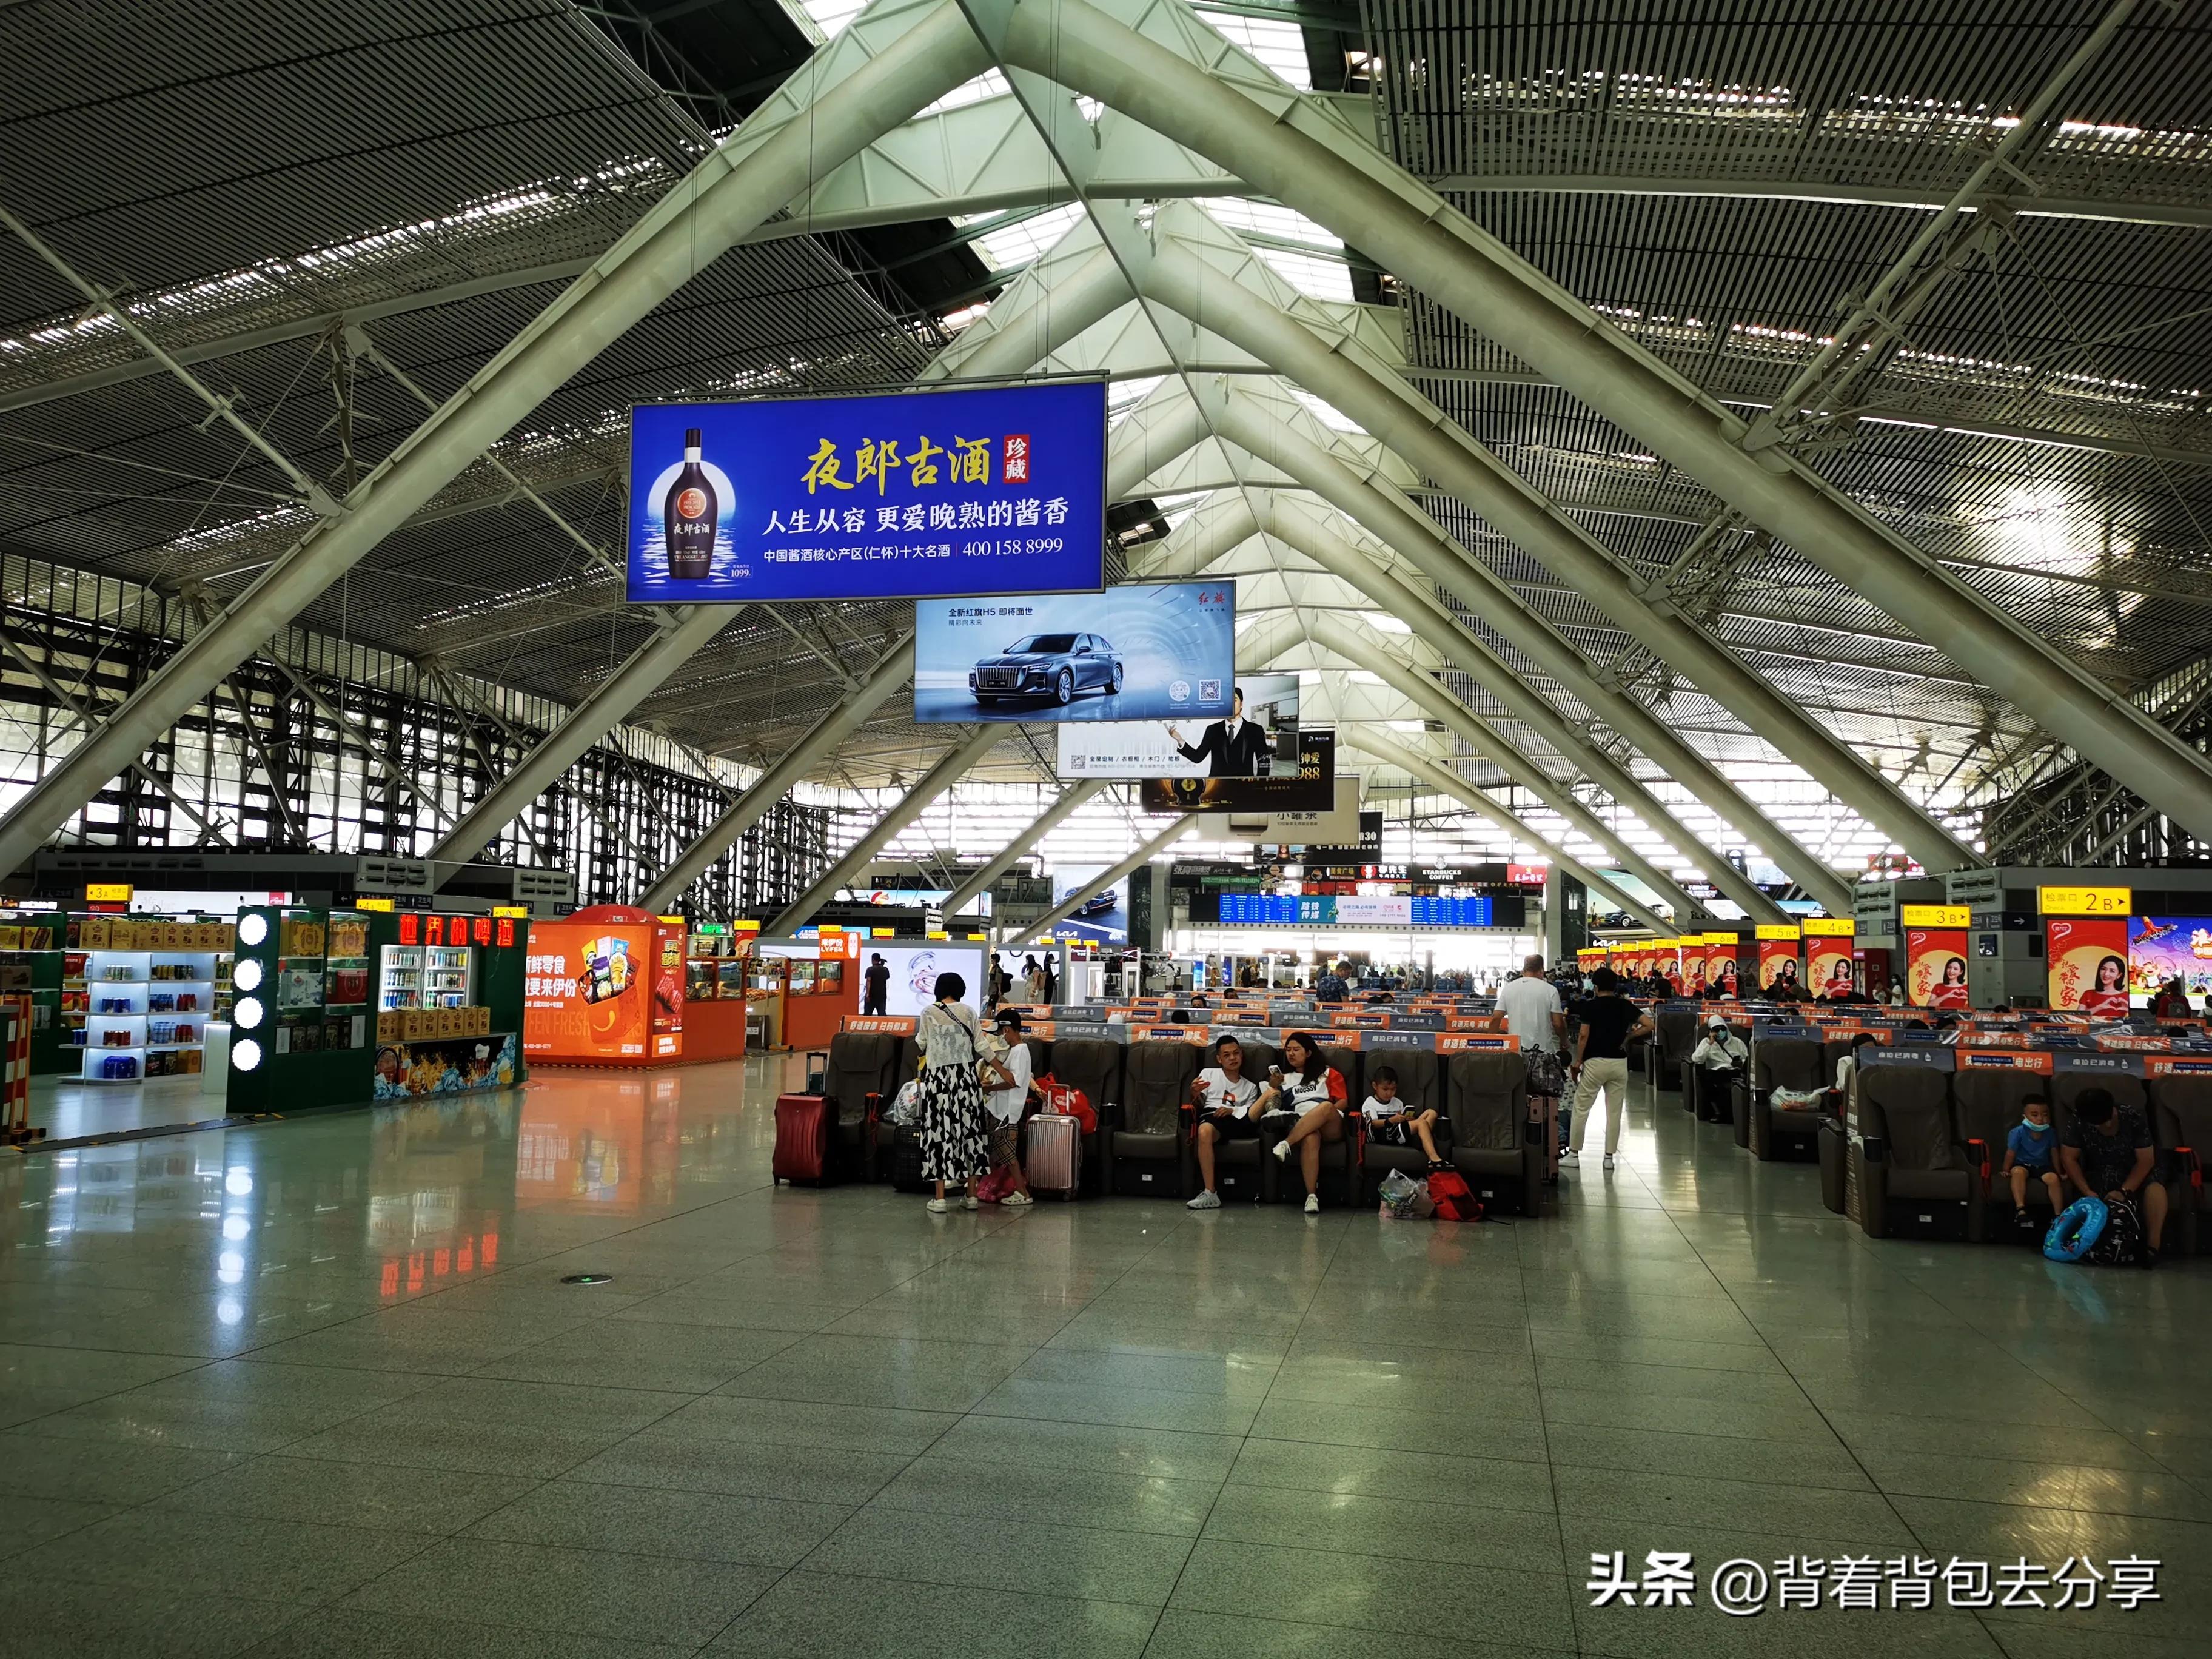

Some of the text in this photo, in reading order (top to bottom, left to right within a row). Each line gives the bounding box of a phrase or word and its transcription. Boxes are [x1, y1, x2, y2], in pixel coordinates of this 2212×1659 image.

[800, 435, 991, 496] 夜郎古酒
[1005, 438, 1027, 480] 珍藏
[762, 497, 1070, 536] 人生从容 更爱晚熟的酱香
[674, 523, 710, 536] 夜郎古酒
[764, 538, 1064, 563] 中国酱酒核心产区(仁怀)十大名酒 400 158 8999
[731, 569, 749, 577] 1099
[1198, 591, 1225, 605] 红旗
[948, 607, 1033, 617] 全新红旗H5 即将面世
[1299, 752, 1320, 764] 钟爱
[1298, 766, 1320, 780] 988
[1301, 902, 1319, 910] 路铁
[1301, 911, 1319, 919] 传媒
[400, 914, 514, 946] 世界的啤酒
[850, 1021, 909, 1031] 舒适按摩 扫码即享
